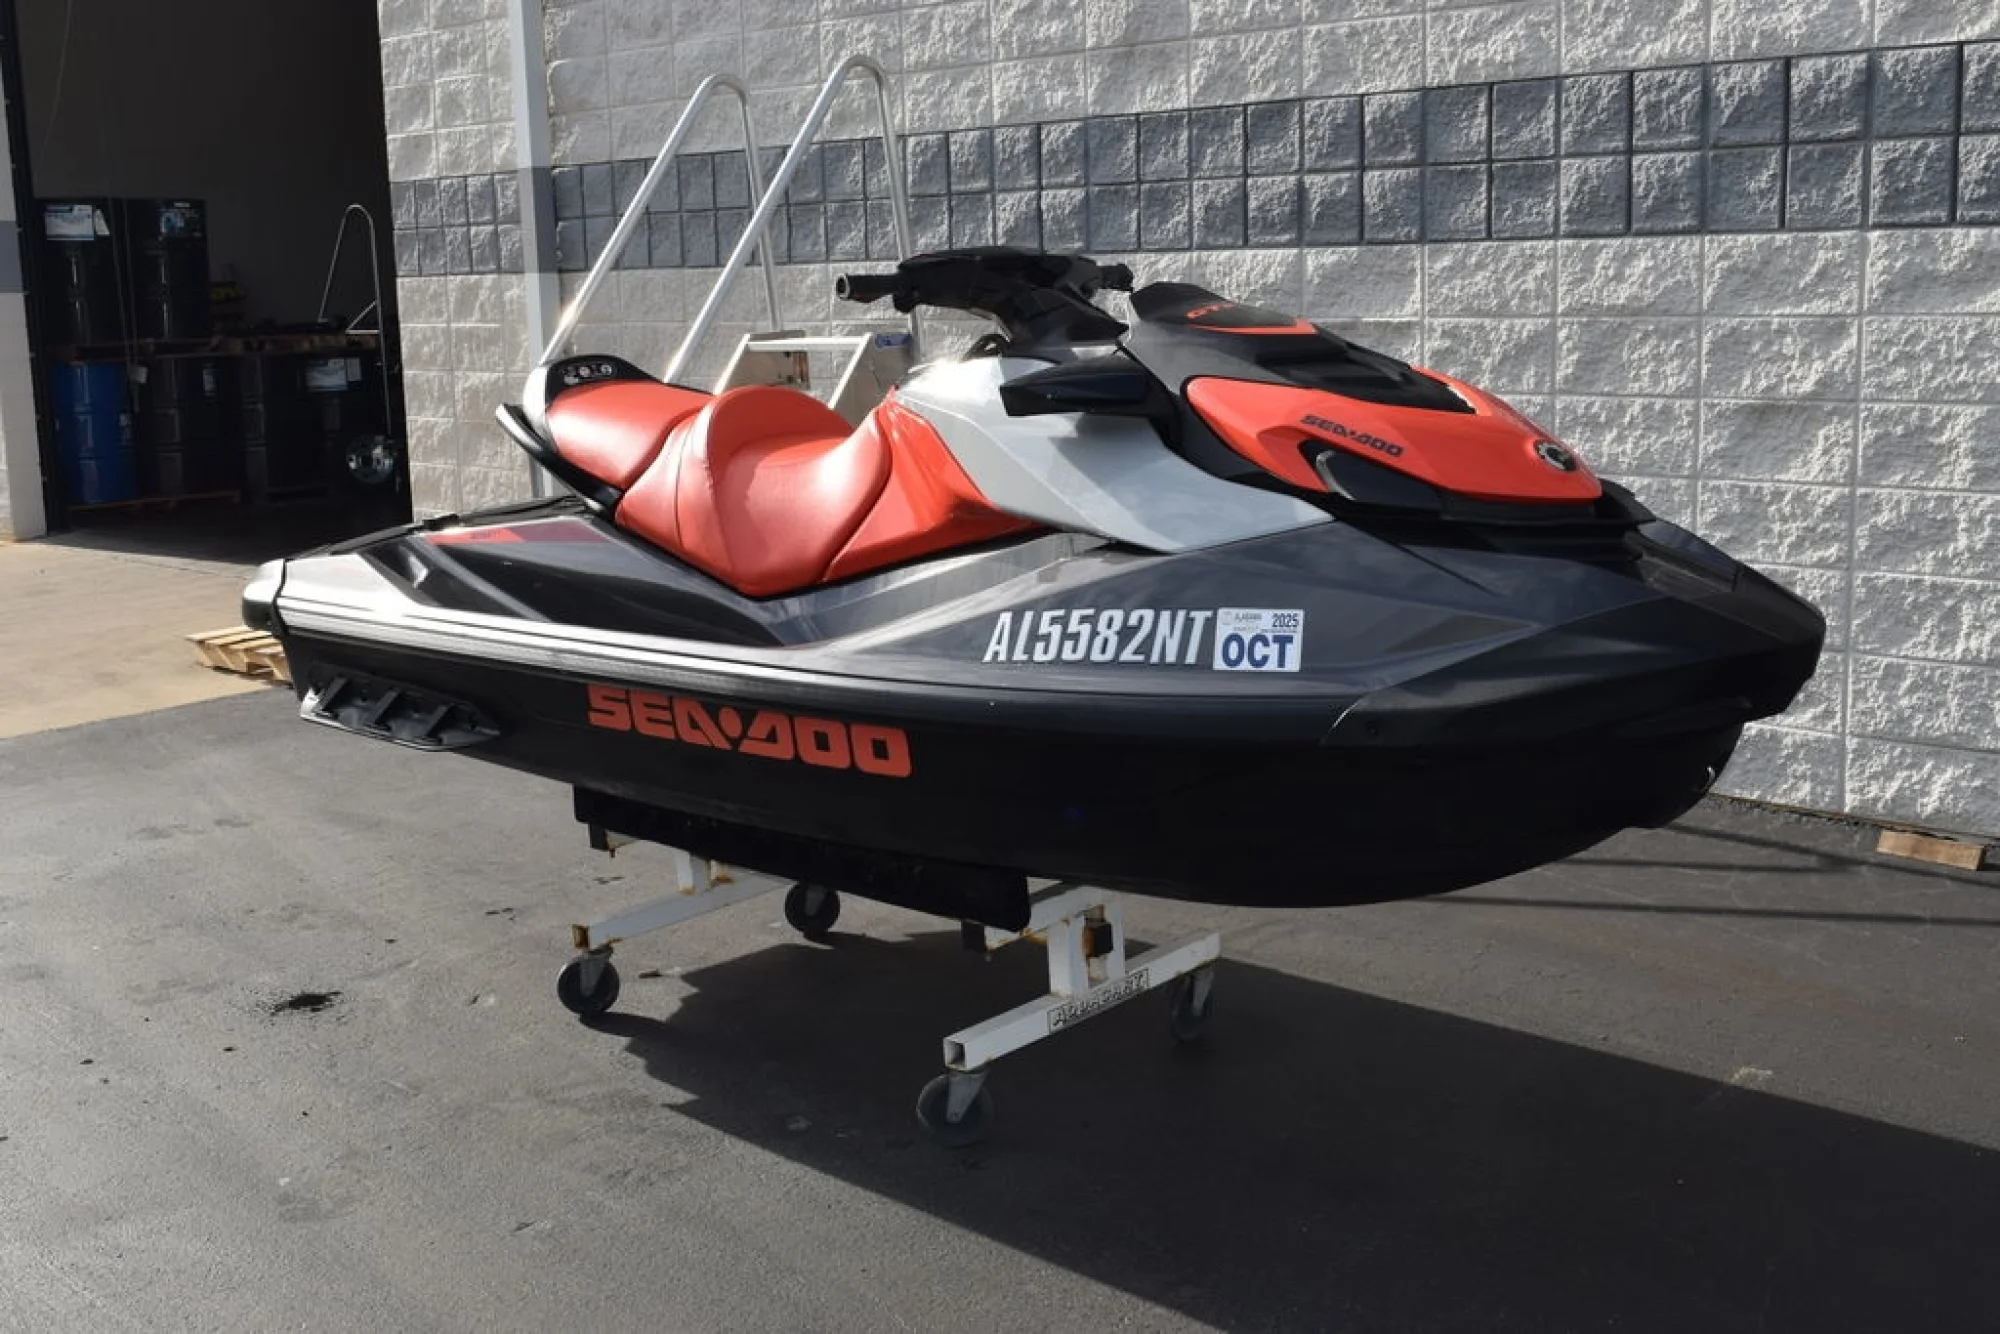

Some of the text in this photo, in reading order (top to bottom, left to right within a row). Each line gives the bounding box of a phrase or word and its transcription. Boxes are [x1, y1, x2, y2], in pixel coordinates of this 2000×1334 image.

[981, 608, 1212, 664] AL5582NT
[1271, 612, 1299, 628] 2025
[1222, 632, 1294, 669] OCT
